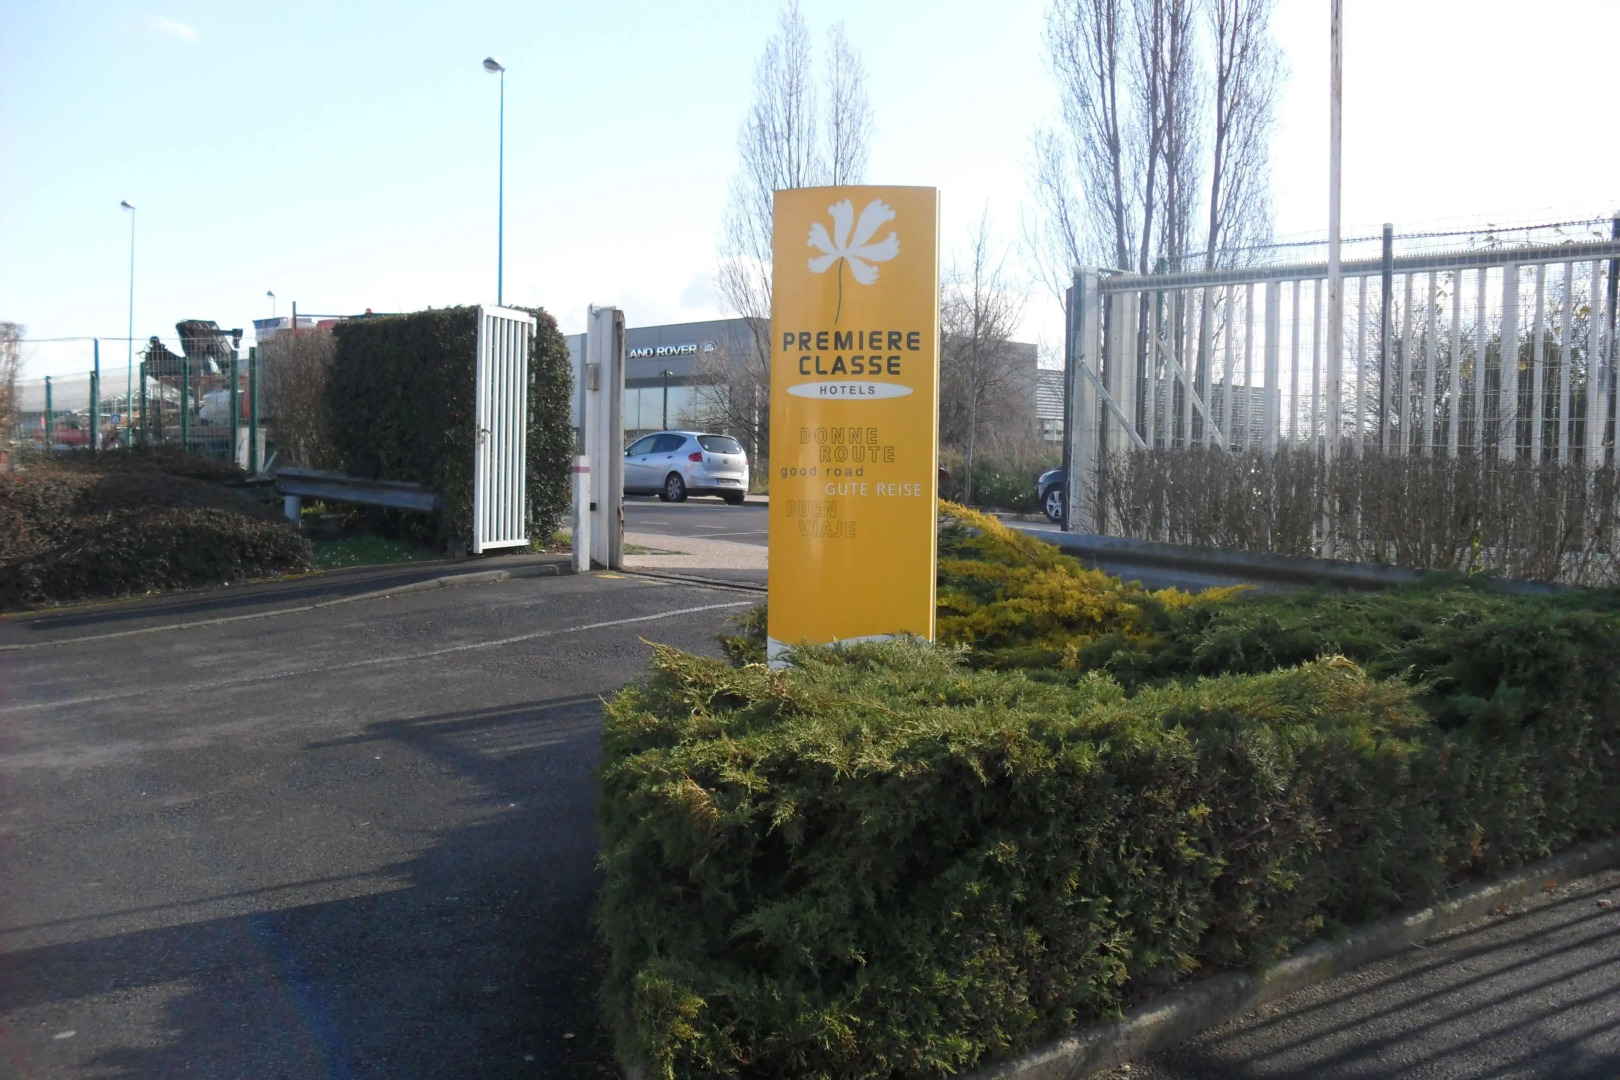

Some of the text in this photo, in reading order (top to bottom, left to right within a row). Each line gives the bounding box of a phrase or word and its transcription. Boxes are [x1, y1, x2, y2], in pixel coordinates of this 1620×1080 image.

[783, 331, 920, 351] PREMIERE
[656, 344, 698, 357] ROVER
[799, 355, 901, 375] CLASSE
[819, 385, 876, 395] HOTELS
[800, 427, 878, 445] BONNE
[819, 445, 895, 463] ROUTE
[780, 465, 865, 479] good road
[824, 482, 922, 497] GUTE REISE
[786, 500, 837, 518] BUEN
[798, 519, 856, 538] VIAJE
